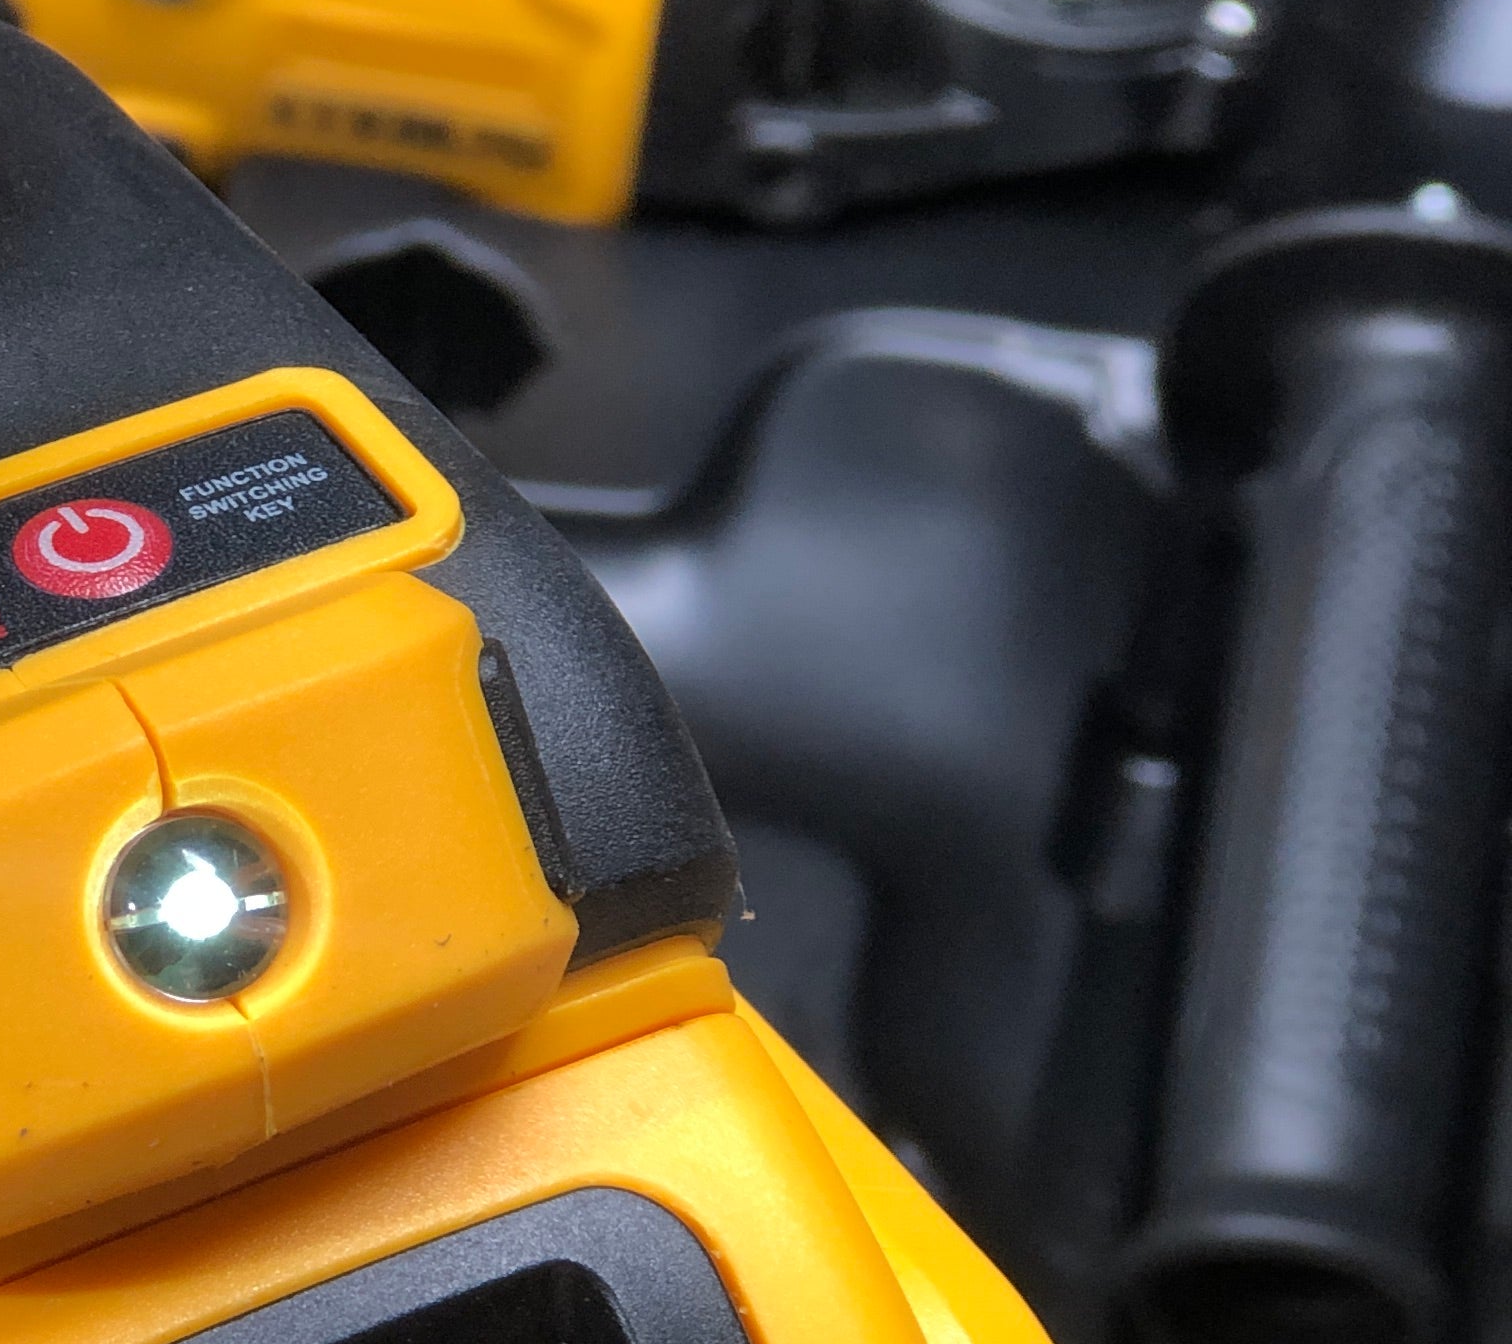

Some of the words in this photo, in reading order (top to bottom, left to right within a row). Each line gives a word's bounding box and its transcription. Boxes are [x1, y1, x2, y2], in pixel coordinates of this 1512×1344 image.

[179, 452, 308, 502] FUNCTION
[188, 467, 329, 521] SWITCHING
[243, 495, 296, 523] KEY
